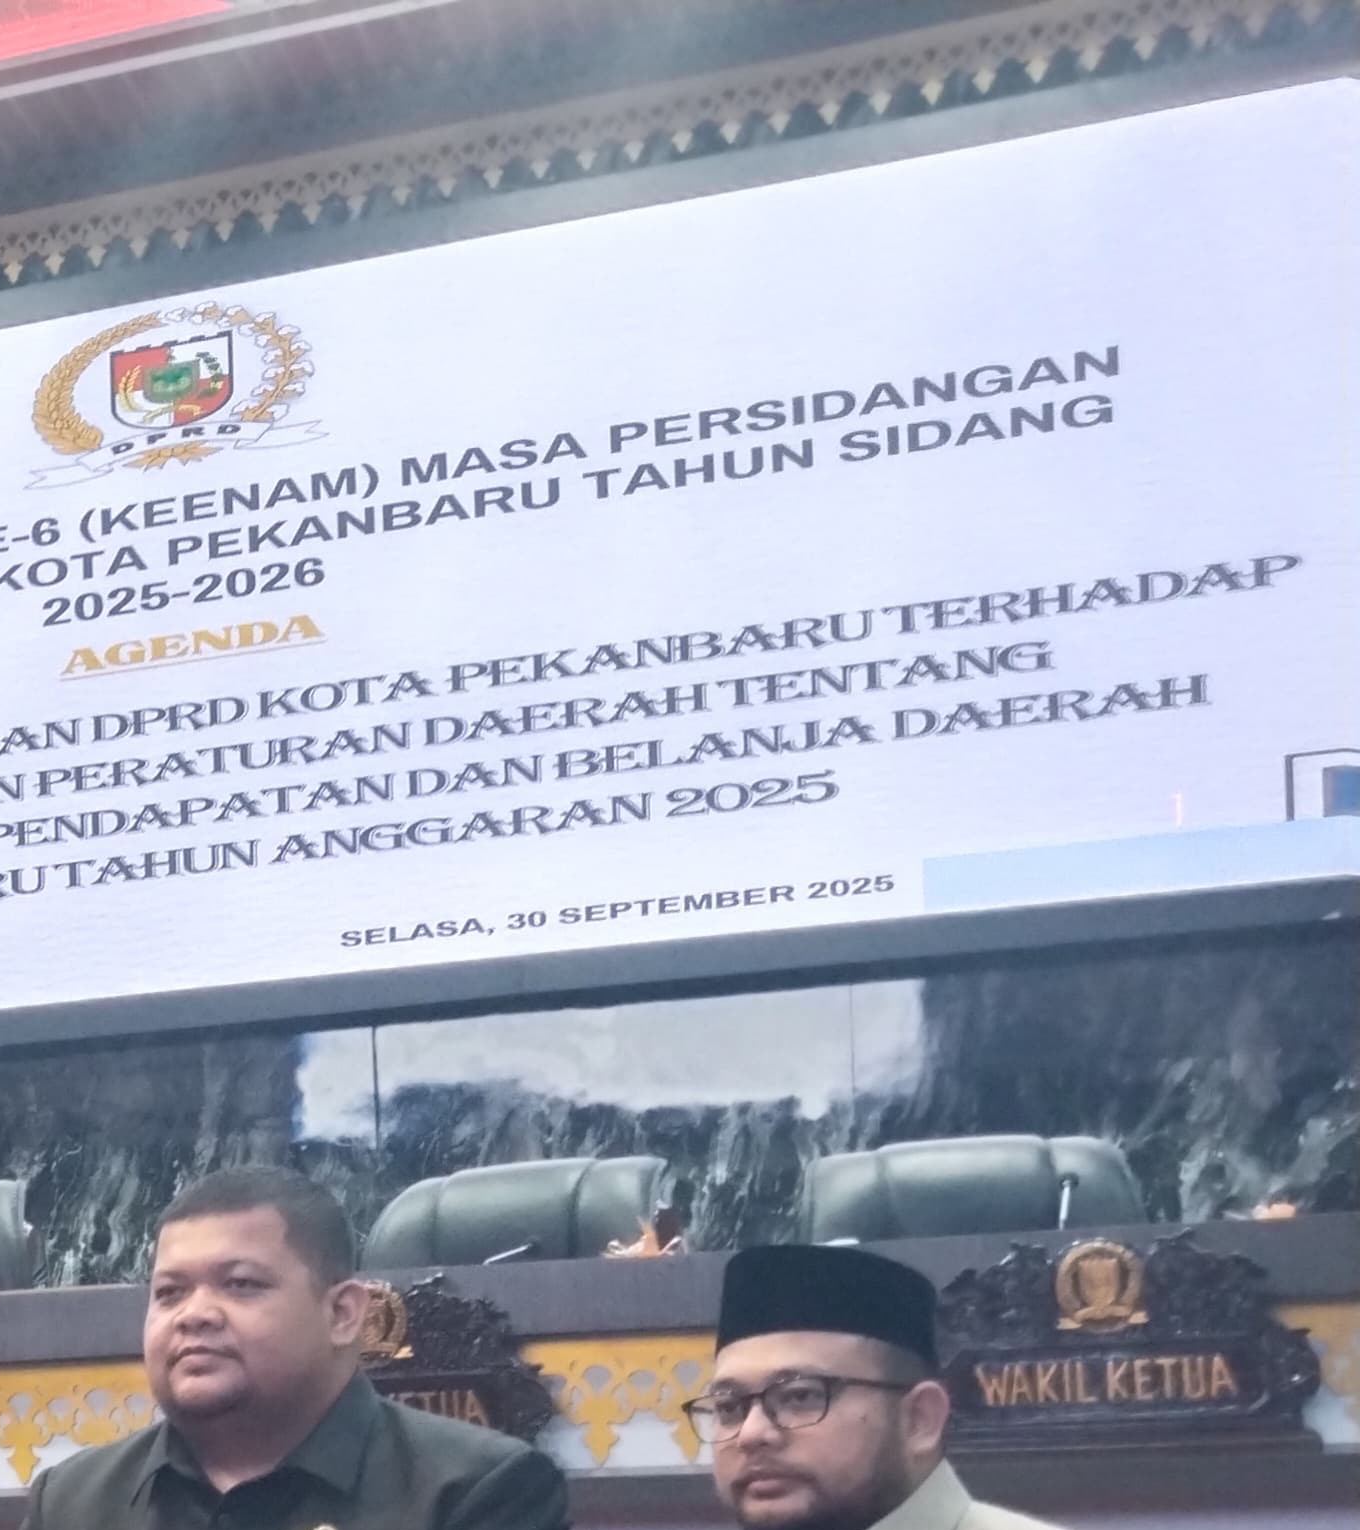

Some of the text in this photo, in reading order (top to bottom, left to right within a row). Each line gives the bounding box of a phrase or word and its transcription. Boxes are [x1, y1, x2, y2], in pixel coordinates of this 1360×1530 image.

[80, 463, 379, 543] (KEENAM)
[401, 432, 587, 486] MASA
[610, 345, 1119, 454] PERSIDANGAN
[111, 424, 242, 456] DPRD
[168, 477, 560, 566] PEKANBARU
[582, 439, 813, 499] TAHUN
[839, 395, 1112, 462] SIDANG
[43, 558, 325, 627] 2025-2026
[60, 613, 326, 676] AGENDA
[92, 697, 249, 742] DPRD
[257, 671, 434, 719] KOTA
[446, 609, 874, 693] PEKANBARU
[881, 555, 1302, 634] TERHADAP
[34, 722, 412, 797] PERATURAN
[424, 683, 707, 746] DAERAH
[716, 641, 1054, 706] TENTANG
[407, 755, 544, 798] DAN
[553, 716, 877, 780] BELANJA
[893, 674, 1207, 740] DAERAH
[52, 840, 260, 888] TAHUN
[269, 792, 651, 864] ANGGARAN
[666, 770, 839, 817] 2025
[341, 875, 894, 947] SELASA, 30 SEPTEMBER 2025
[974, 1352, 1239, 1407] WAKIL KETUA
